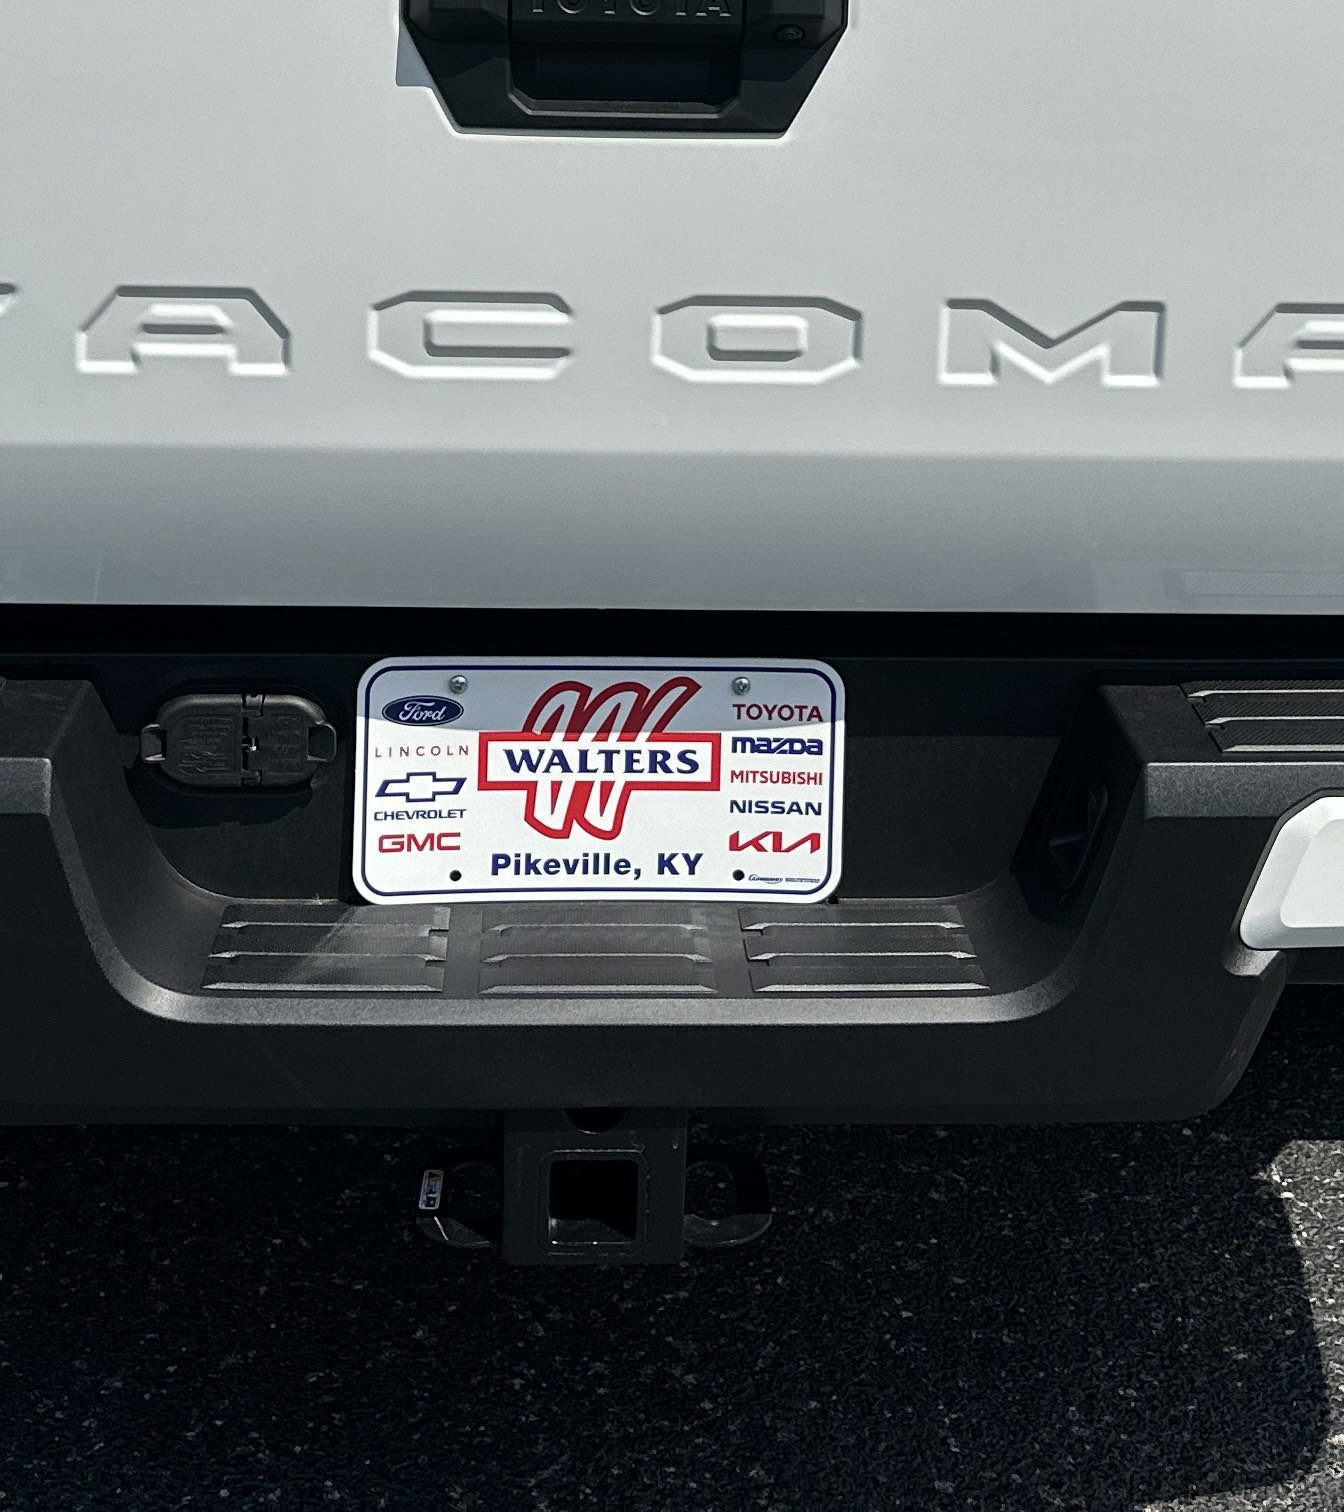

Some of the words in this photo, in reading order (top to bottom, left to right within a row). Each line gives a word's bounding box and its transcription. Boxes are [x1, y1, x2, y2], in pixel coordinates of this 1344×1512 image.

[399, 701, 447, 721] Ford
[732, 703, 824, 723] TOYOTA
[375, 745, 469, 758] LINCOLN
[502, 748, 700, 774] WALTERS
[730, 769, 823, 786] MITSUBISHI
[374, 808, 467, 822] CHEVROLET
[729, 799, 822, 816] NISSAN
[378, 831, 461, 854] GMC
[729, 830, 821, 854] KIA
[491, 852, 642, 881] Pikeville,
[657, 852, 704, 875] KY
